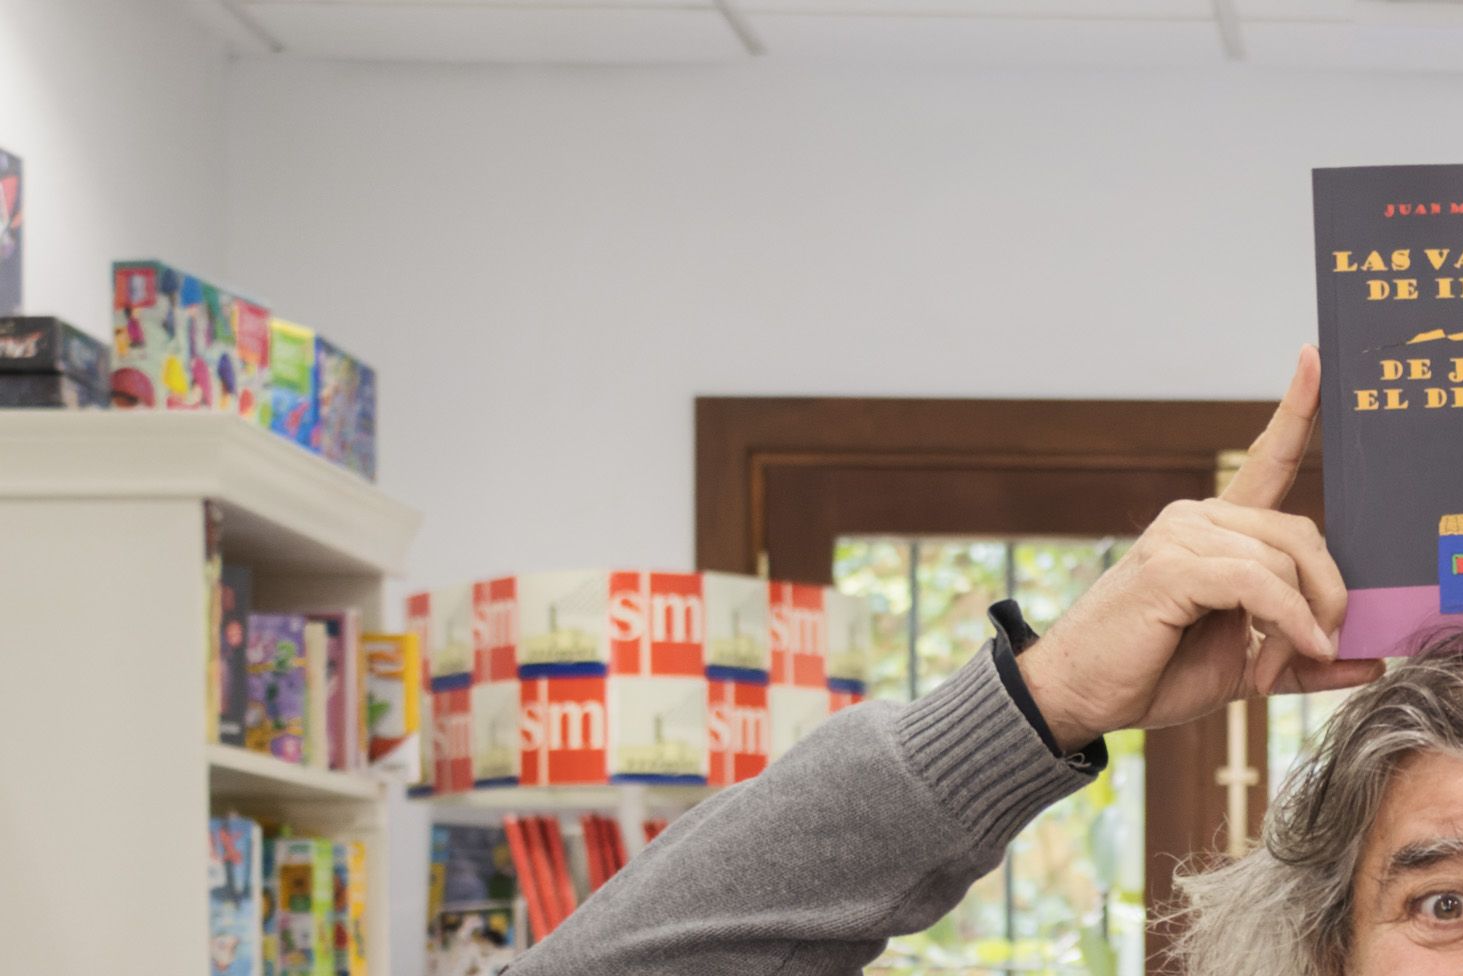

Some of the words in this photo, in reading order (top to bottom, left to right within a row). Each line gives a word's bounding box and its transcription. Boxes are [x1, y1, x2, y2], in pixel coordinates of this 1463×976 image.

[1384, 203, 1441, 218] JUAN
[1332, 249, 1411, 272] LAS
[1366, 278, 1419, 300] DE
[1380, 358, 1431, 380] DE
[1354, 389, 1408, 411] EL
[473, 602, 517, 650] sm
[609, 590, 704, 643] sm
[769, 604, 826, 656] sm
[518, 699, 605, 754] sm
[708, 704, 769, 755] sm
